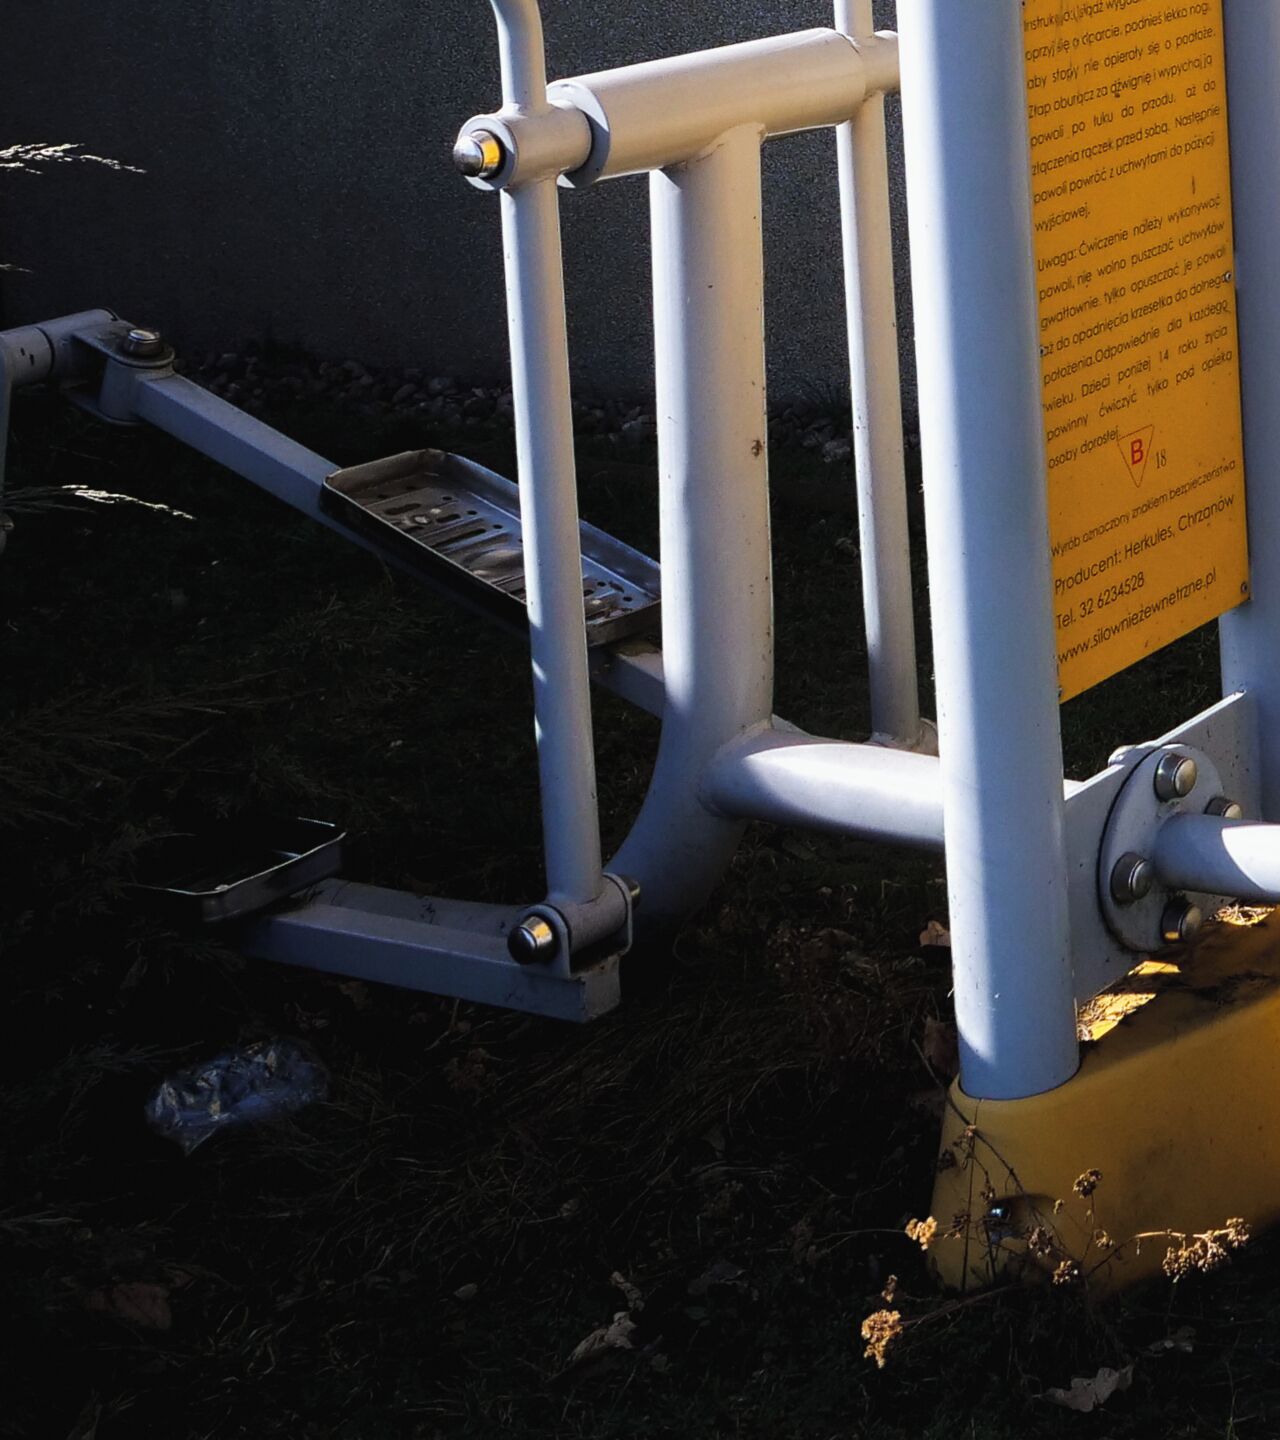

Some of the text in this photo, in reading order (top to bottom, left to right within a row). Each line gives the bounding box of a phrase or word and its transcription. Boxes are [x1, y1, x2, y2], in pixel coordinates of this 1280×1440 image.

[1025, 41, 1055, 61] oprzyj
[1057, 40, 1069, 54] się
[1072, 37, 1079, 47] o
[1125, 13, 1162, 35] podnieś
[1164, 5, 1187, 21] lekko
[1027, 74, 1046, 90] aby
[1052, 64, 1079, 83] stopy
[1084, 58, 1099, 75] nie
[1104, 45, 1143, 67] opierały
[1148, 42, 1159, 56] się
[1165, 39, 1171, 49] o
[1028, 103, 1051, 119] Złap
[1053, 89, 1094, 111] oburącz
[1096, 84, 1108, 98] za
[1158, 55, 1202, 79] wypychaj
[1031, 124, 1064, 147] powoli
[1072, 120, 1085, 136] po
[1093, 111, 1113, 127] łuku
[1121, 105, 1134, 118] do
[1186, 85, 1197, 98] aż
[1203, 79, 1216, 92] do
[1031, 150, 1079, 176] złączenia
[1081, 139, 1114, 160] rączek
[1116, 128, 1143, 150] przed
[1175, 104, 1220, 128] Następnie
[1033, 181, 1067, 205] powoli
[1069, 168, 1107, 193] powróć
[1116, 150, 1167, 176] uchwytami
[1170, 143, 1182, 157] do
[1038, 196, 1220, 272] Uwaga: Ćwiczenie należy wykonywać
[1039, 221, 1225, 302] powoli, nie wolno puszczać uchwytów
[1104, 285, 1126, 304] tylko
[1130, 263, 1179, 293] opuszczać
[1183, 259, 1192, 276] je
[1057, 336, 1070, 351] do
[1072, 312, 1129, 345] opadnięcia
[1130, 295, 1172, 321] krzesełka
[1175, 287, 1188, 302] do
[1168, 316, 1182, 333] dla
[1189, 299, 1228, 323] każdego
[1082, 374, 1110, 398] Dzieci
[1118, 357, 1151, 383] poniżej
[1159, 350, 1169, 363] 14
[1178, 338, 1197, 355] roku
[1047, 413, 1088, 442] powinny
[1099, 390, 1137, 418] ćwiczyć
[1147, 378, 1168, 397] tylko
[1176, 364, 1195, 385] pod
[1049, 449, 1078, 469] osoby
[1131, 438, 1143, 465] B
[1156, 449, 1167, 469] 18
[1051, 459, 1236, 557] Wyrób oznaczony znakiem bezpieczeństwa
[1055, 494, 1235, 596] Producent: Herkules, Chrzanów
[1056, 572, 1145, 630] Tel. 32 6234528
